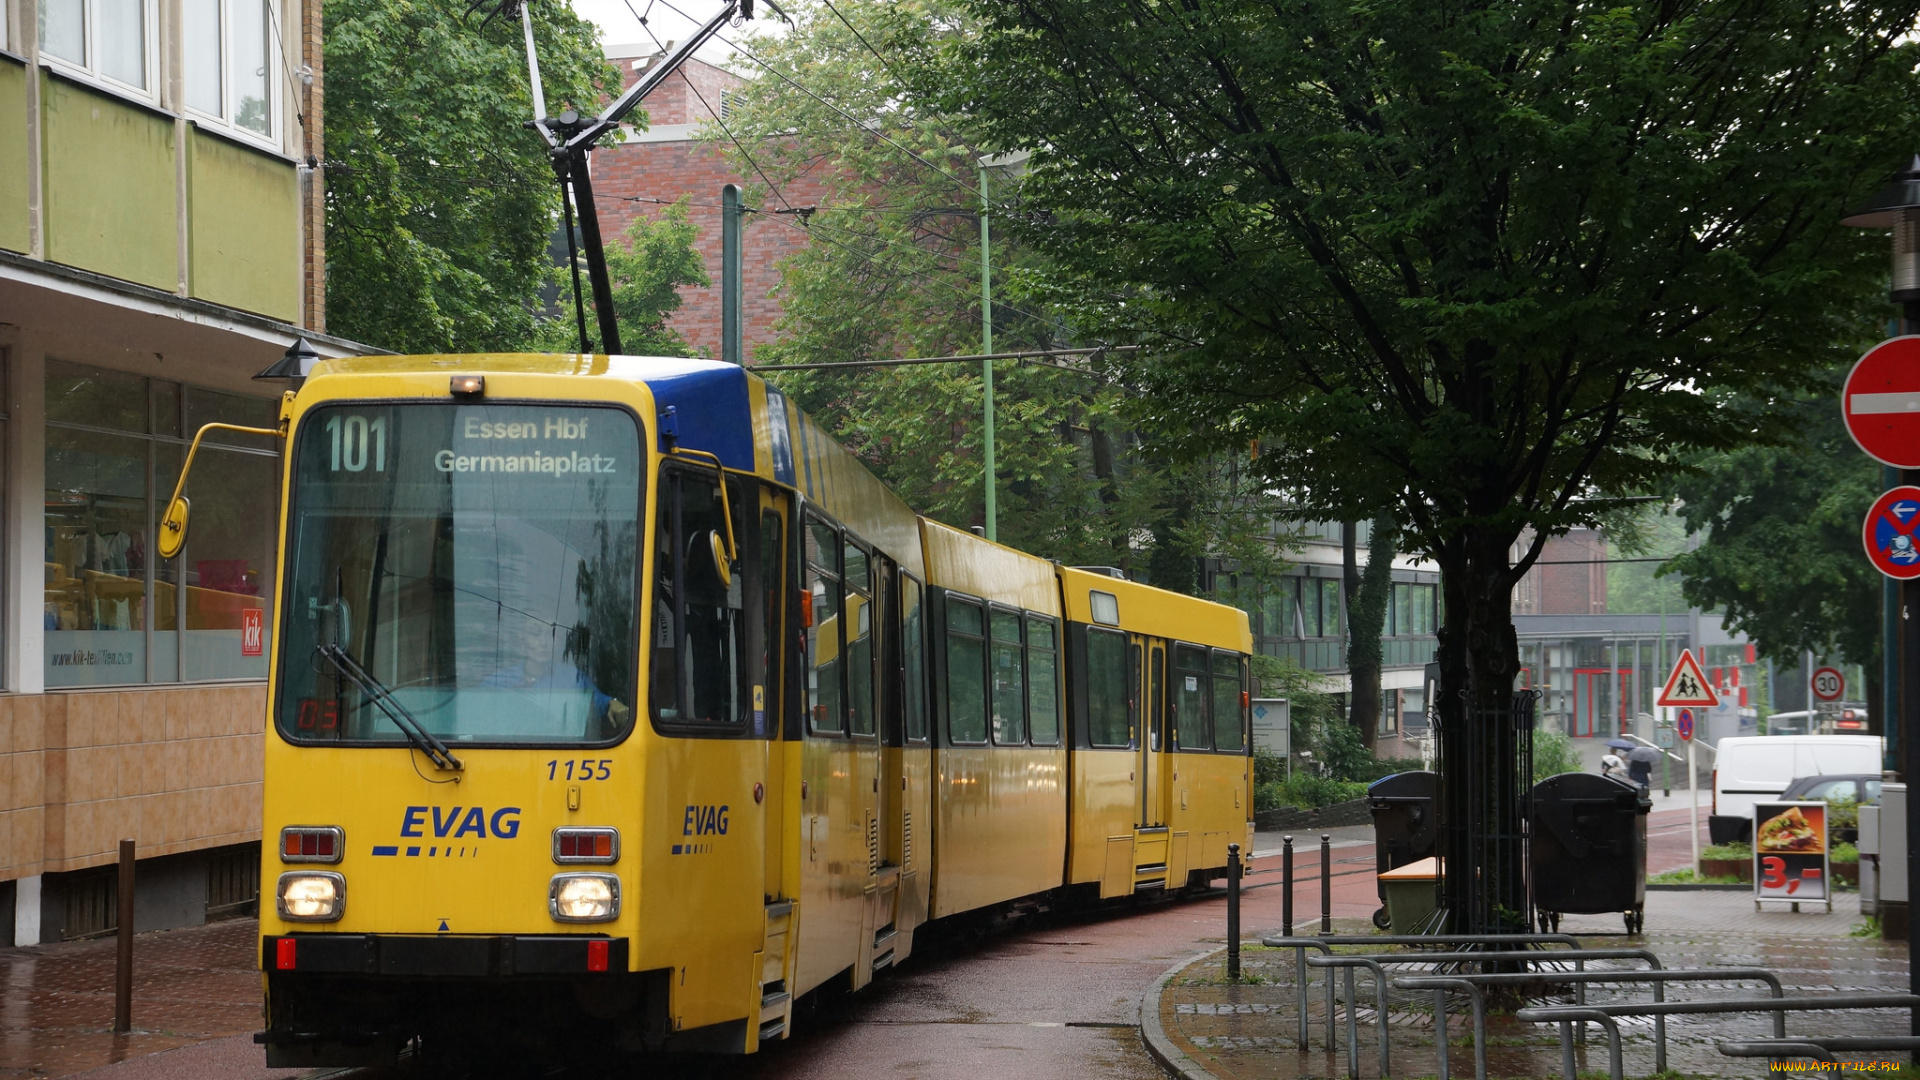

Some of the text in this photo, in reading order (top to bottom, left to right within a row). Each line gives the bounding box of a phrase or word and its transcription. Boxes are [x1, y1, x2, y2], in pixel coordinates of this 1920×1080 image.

[464, 417, 590, 439] Essen Hbf
[326, 415, 386, 472] 101
[434, 450, 617, 477] Germaniaplatz
[51, 649, 133, 666] www.kik-telien.com
[1817, 676, 1837, 692] 30
[547, 759, 613, 781] 1155
[400, 806, 522, 839] EVAG
[682, 804, 729, 836] EVAG
